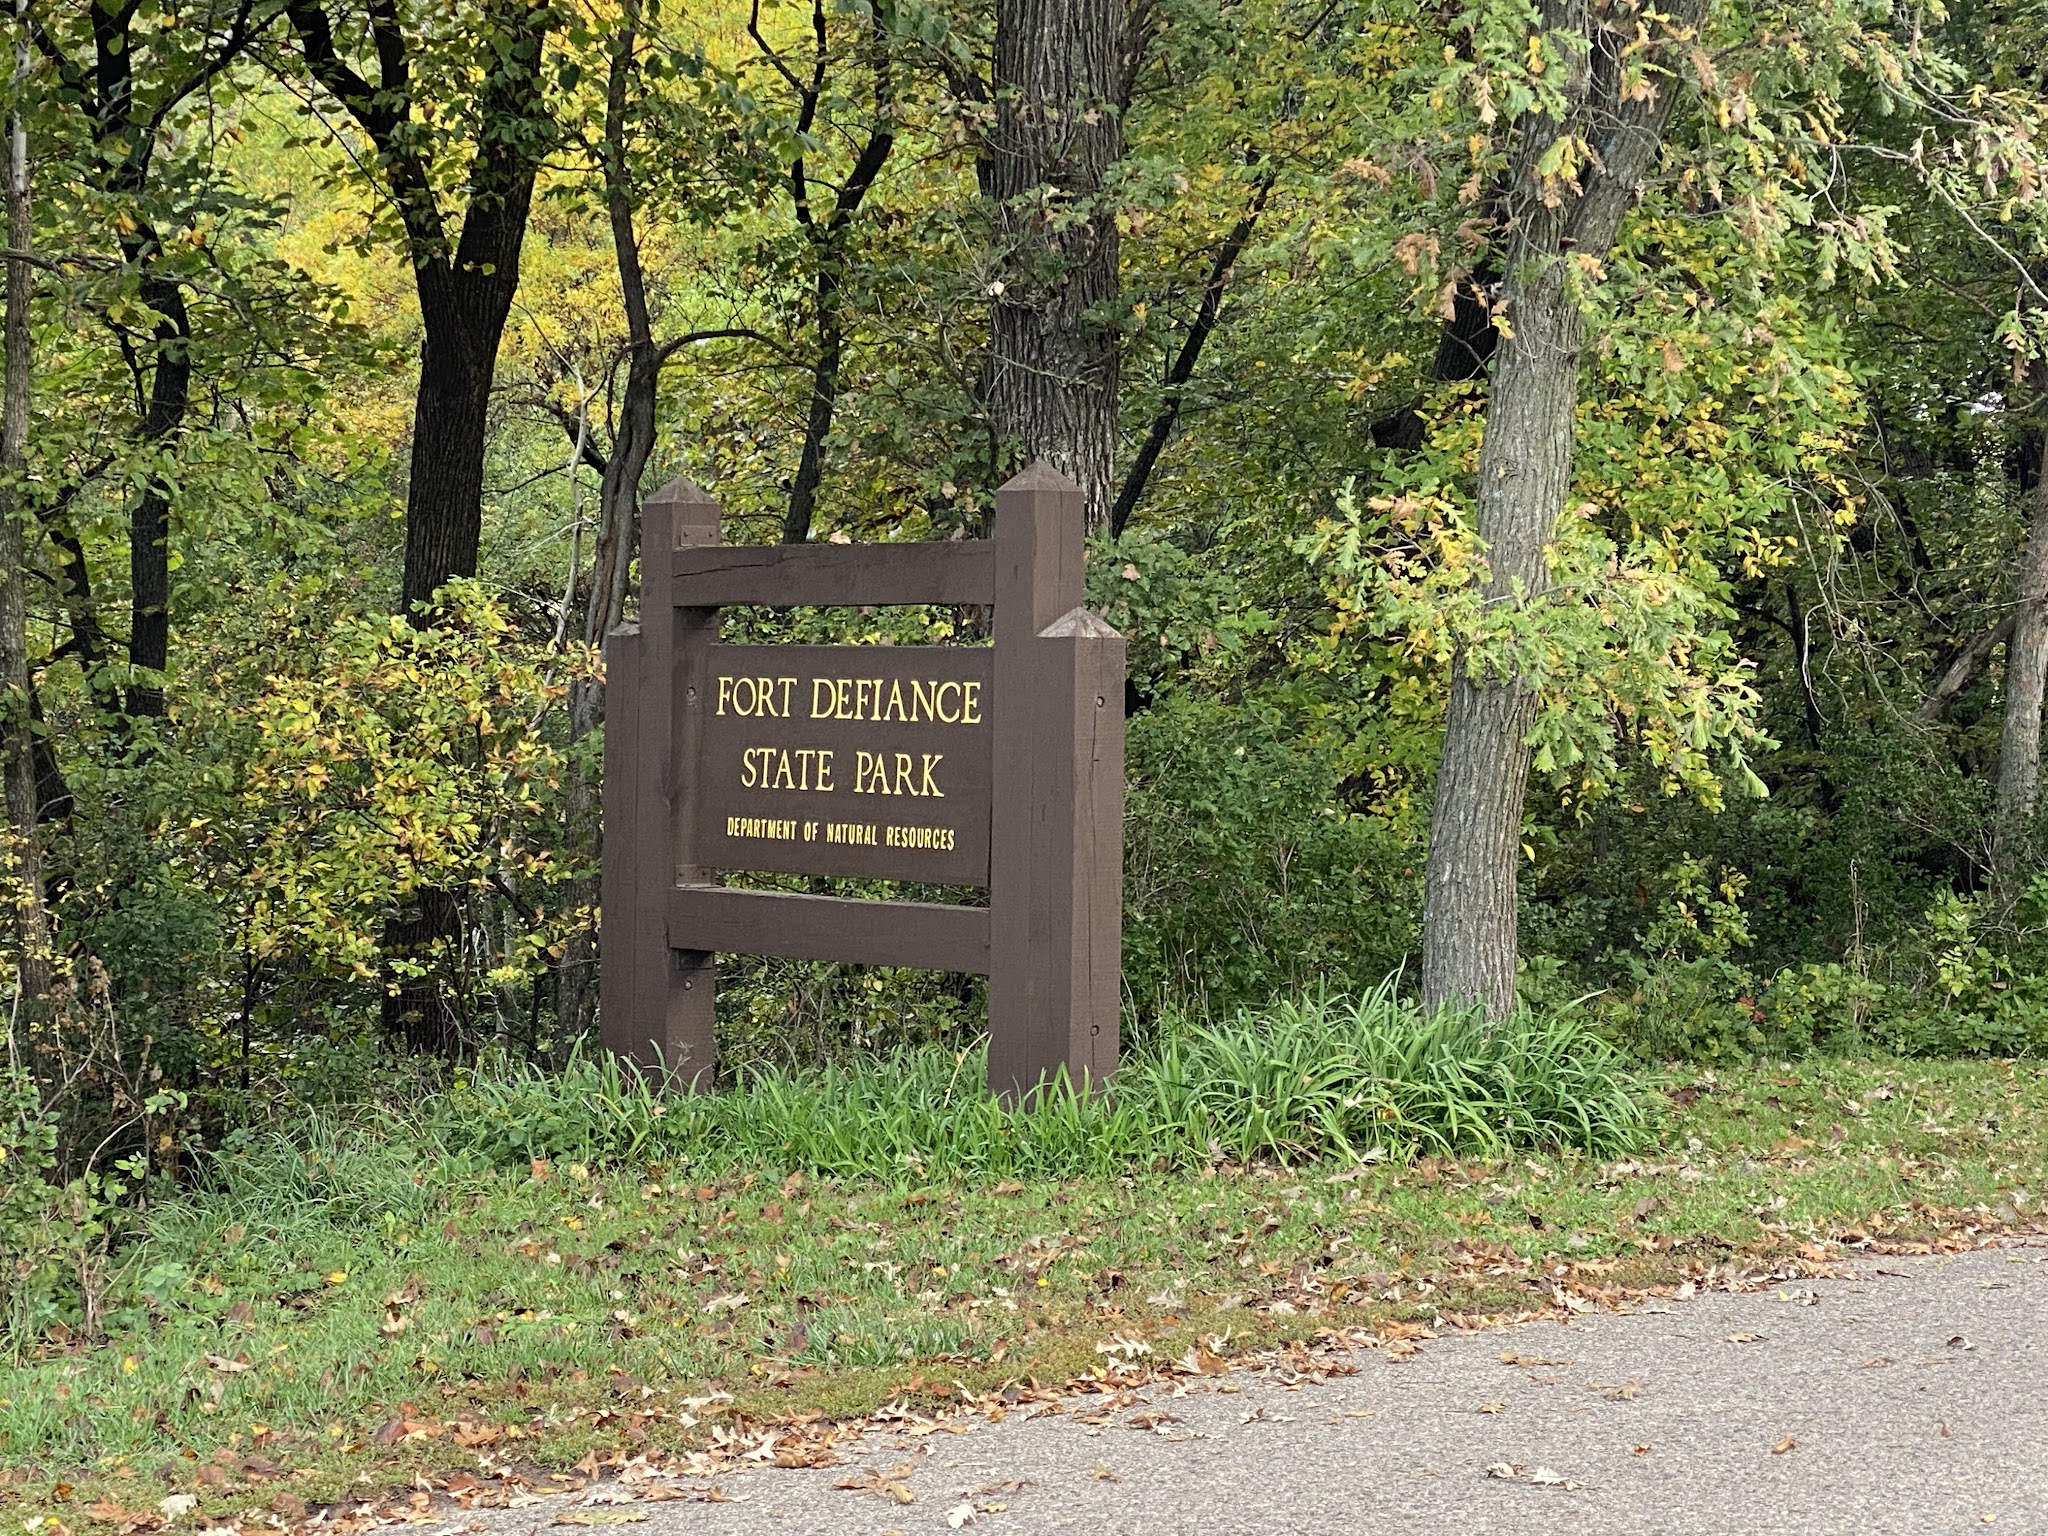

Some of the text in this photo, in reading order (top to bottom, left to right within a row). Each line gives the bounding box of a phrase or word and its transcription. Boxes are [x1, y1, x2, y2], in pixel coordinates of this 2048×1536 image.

[715, 676, 982, 724] FORT DEFIANCE
[741, 747, 945, 798] STATE PARK
[726, 816, 955, 851] DEPARTMENT OF NATURAL RESOURCES
